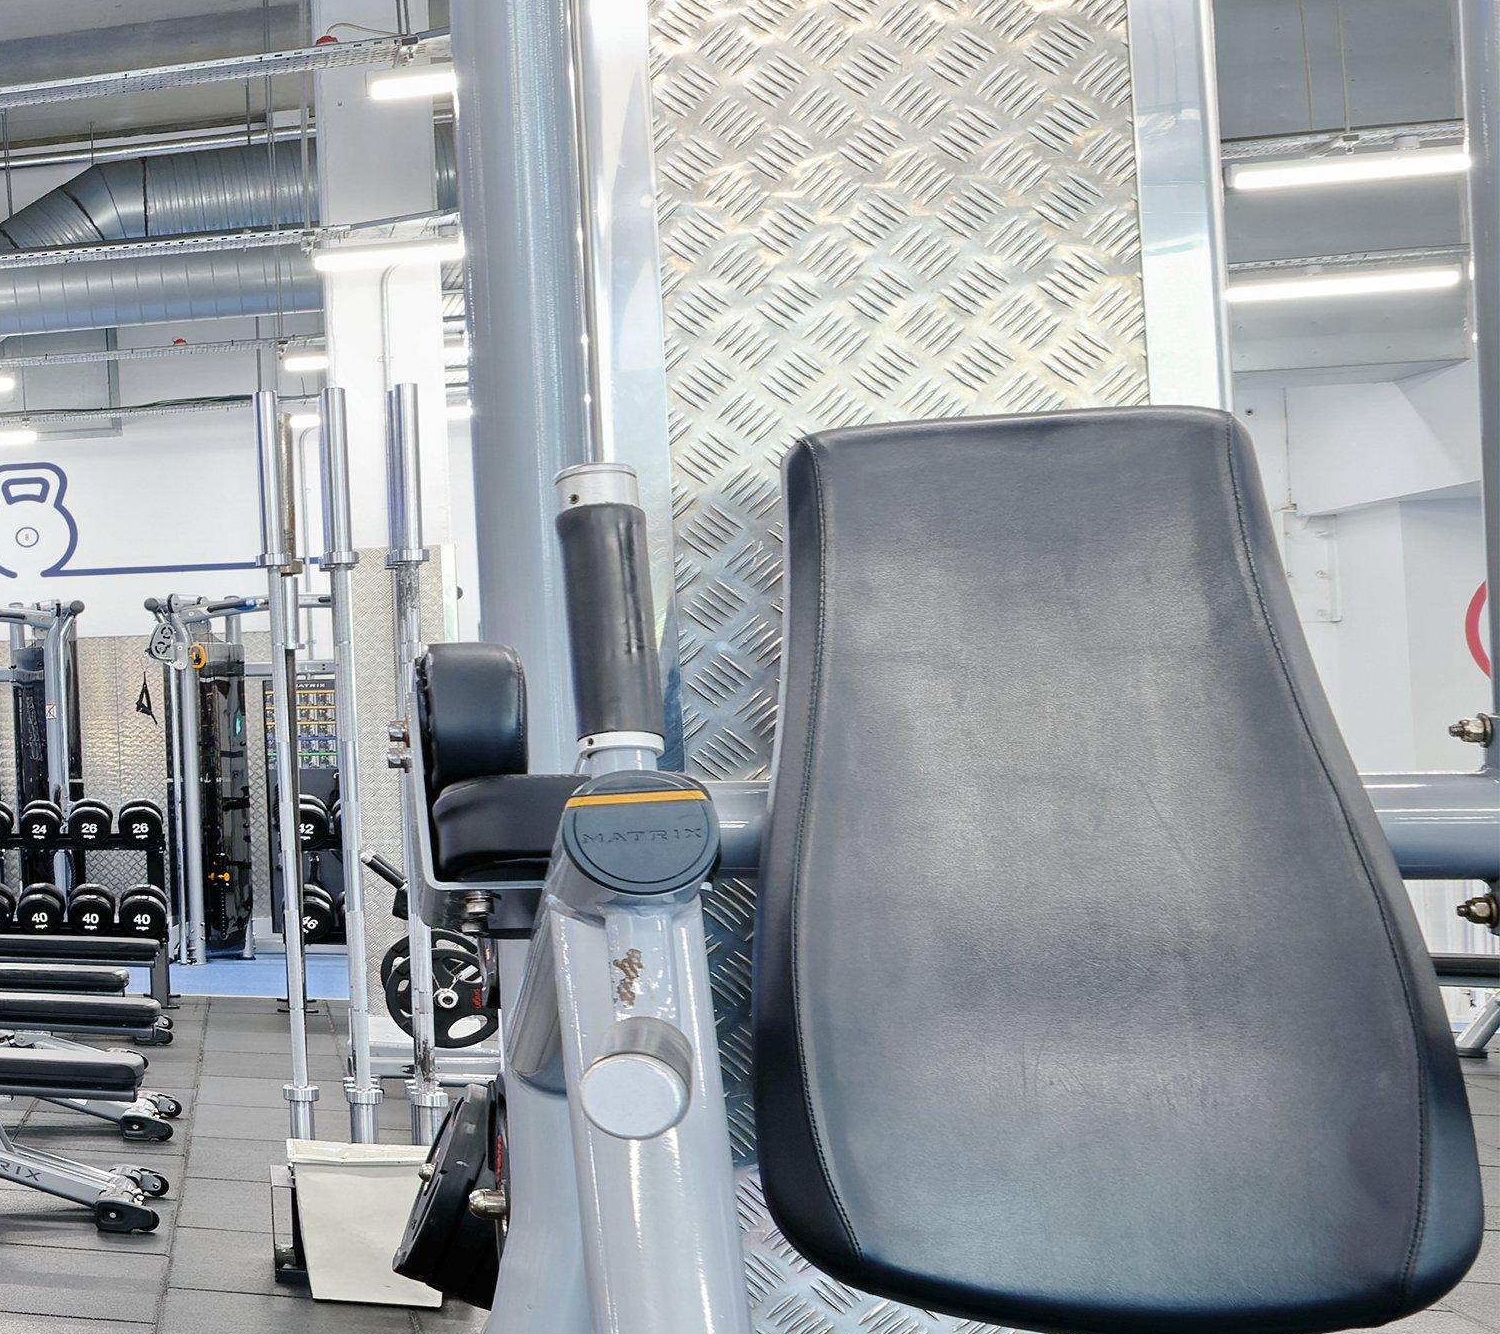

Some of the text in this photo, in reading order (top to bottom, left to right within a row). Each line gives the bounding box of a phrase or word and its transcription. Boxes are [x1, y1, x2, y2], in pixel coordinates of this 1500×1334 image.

[32, 825, 47, 834] 24
[82, 823, 97, 833] 26
[132, 823, 148, 833] 26
[581, 825, 702, 846] MATRIX
[32, 912, 48, 923] 40
[82, 913, 99, 923] 40
[134, 914, 150, 925] 40
